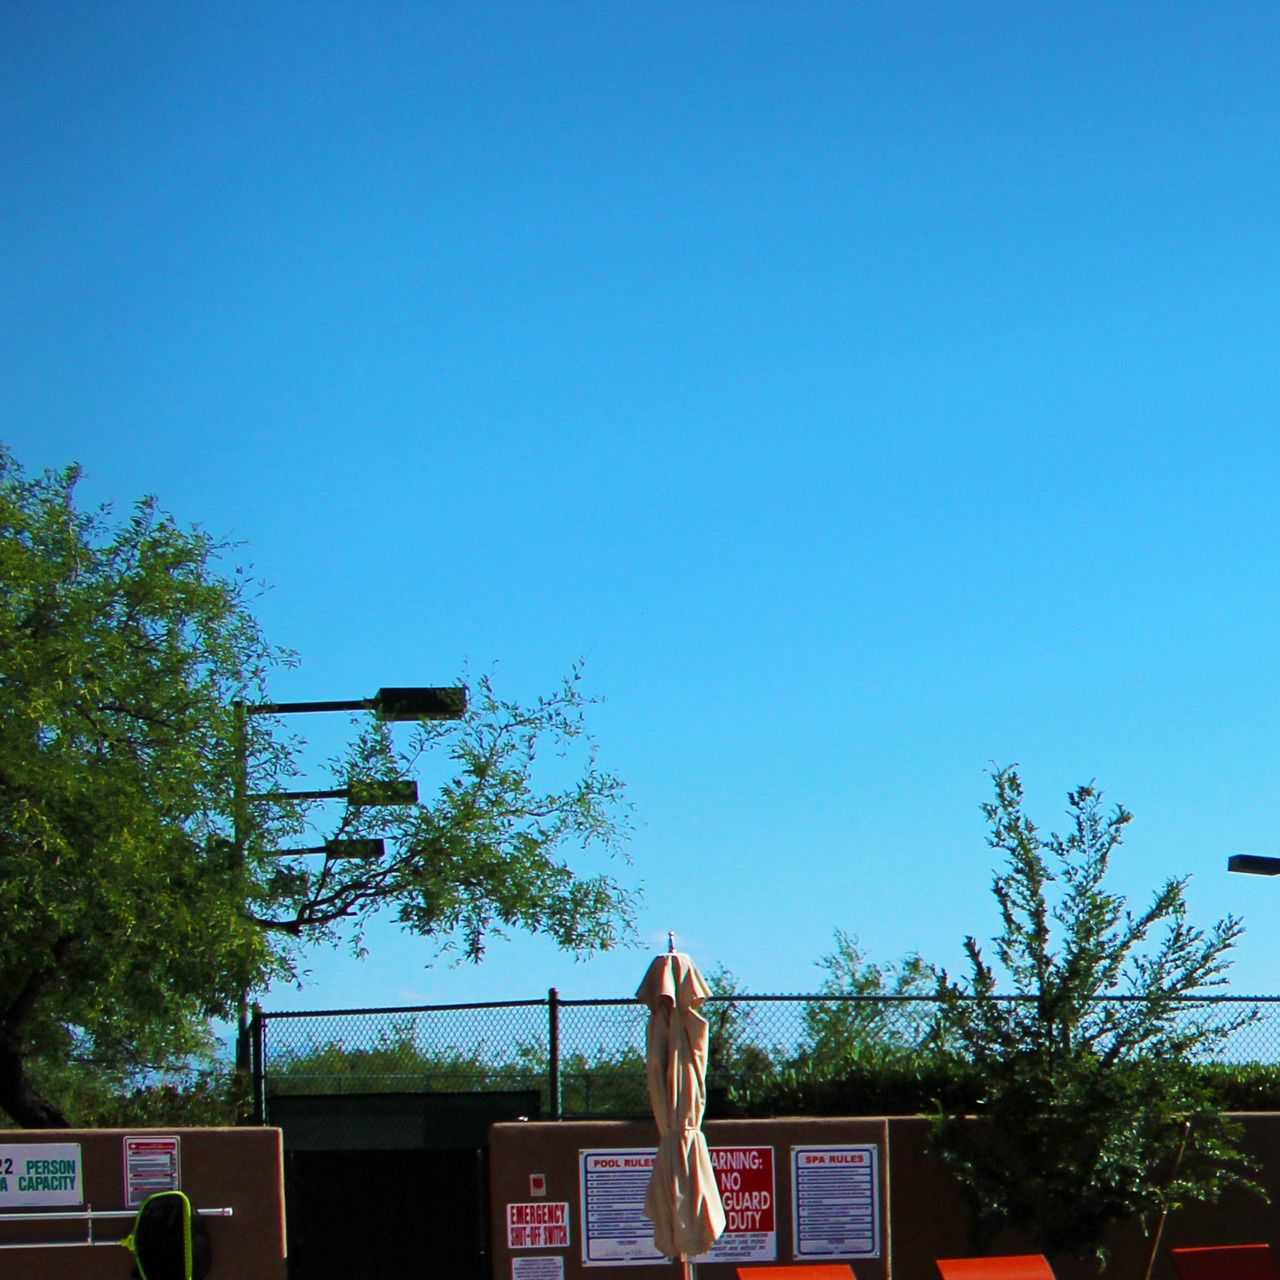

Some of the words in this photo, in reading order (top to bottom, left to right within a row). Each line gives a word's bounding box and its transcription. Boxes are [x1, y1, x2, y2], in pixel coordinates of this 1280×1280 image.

[26, 1160, 76, 1175] PERSON
[593, 1159, 621, 1168] POOL
[710, 1151, 763, 1170] ARNING:
[805, 1155, 826, 1164] SPA
[829, 1155, 864, 1164] RULES
[18, 1175, 76, 1191] CAPACITY
[721, 1172, 741, 1191] NO
[511, 1204, 566, 1225] EMERGENCY
[728, 1211, 762, 1230] DUTY
